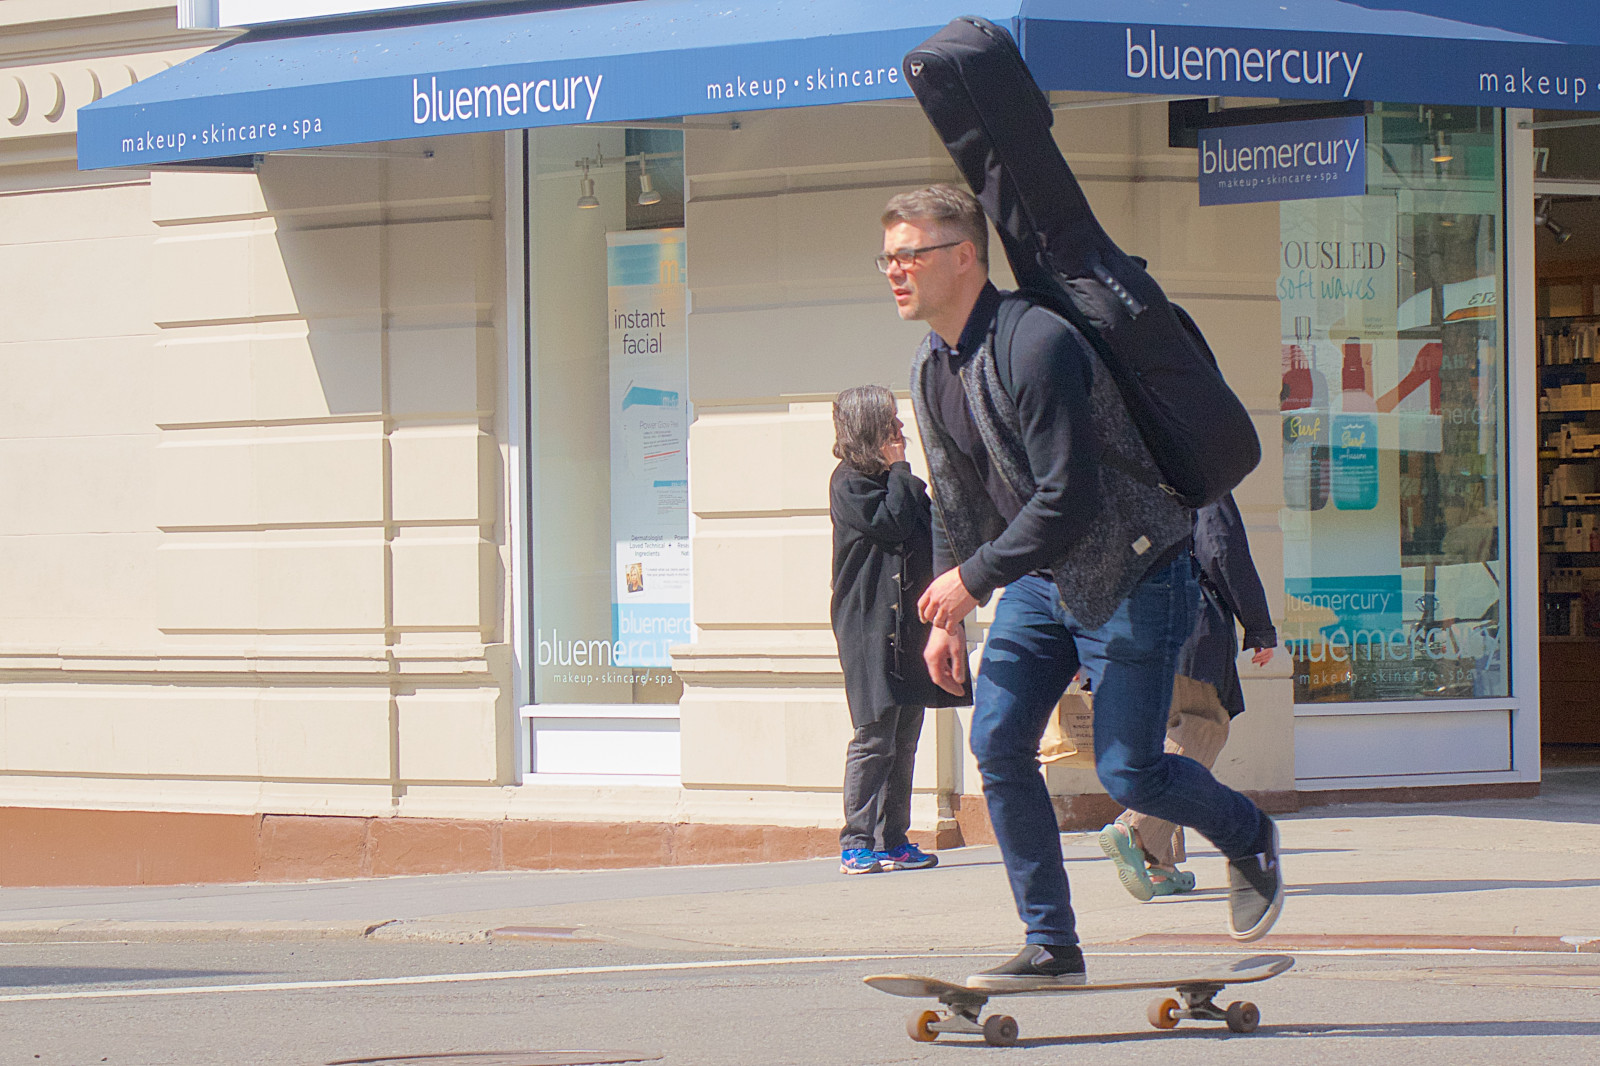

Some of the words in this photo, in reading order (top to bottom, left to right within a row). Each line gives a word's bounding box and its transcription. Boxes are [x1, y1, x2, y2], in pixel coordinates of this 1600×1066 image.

[1126, 27, 1363, 97] bluemercury
[706, 75, 786, 100] makeup
[806, 66, 898, 91] skincare
[1479, 67, 1587, 104] makeup
[412, 74, 603, 124] bluemercury
[122, 131, 187, 153] makeup
[202, 122, 277, 145] skincare
[293, 117, 322, 140] spa
[1202, 138, 1360, 174] bluemercury
[1218, 178, 1258, 189] makeup
[1267, 173, 1312, 186] skincare
[1320, 171, 1338, 183] spa
[1280, 241, 1386, 270] OUSLED
[1280, 270, 1316, 300] soft
[1321, 276, 1376, 300] waves
[614, 308, 666, 329] instant
[622, 332, 662, 355] facial
[1290, 416, 1321, 441] Surf
[1287, 588, 1390, 615] luemercury
[620, 609, 691, 635] bluemerc
[553, 671, 593, 686] makeup
[601, 671, 647, 685] skincare
[655, 674, 674, 687] spa
[1300, 670, 1358, 687] makeup
